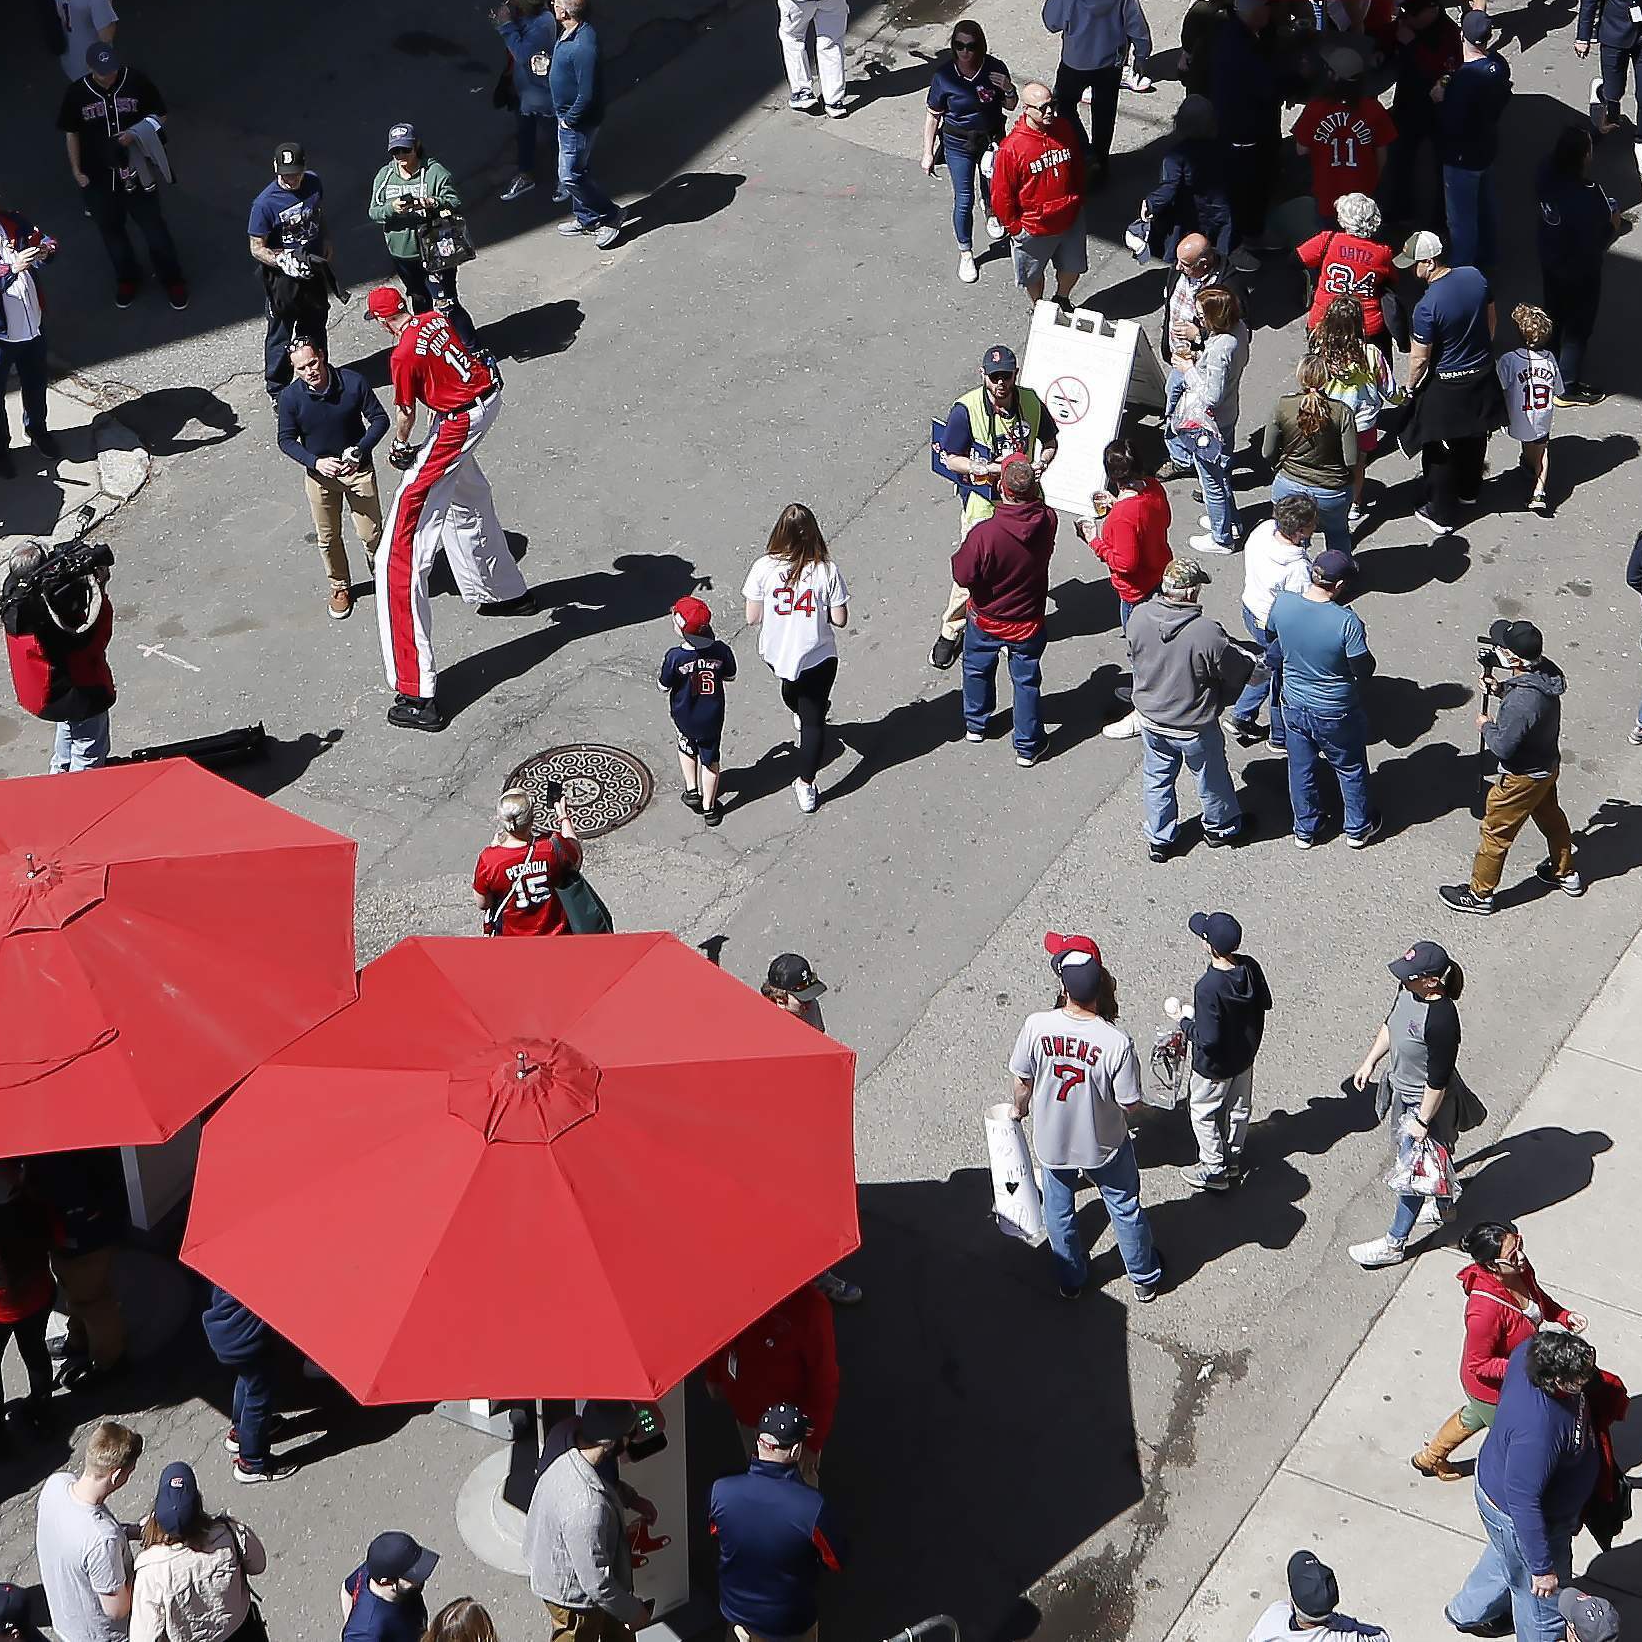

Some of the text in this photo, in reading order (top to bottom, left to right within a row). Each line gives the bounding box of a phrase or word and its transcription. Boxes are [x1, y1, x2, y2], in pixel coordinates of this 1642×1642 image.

[1313, 111, 1350, 144] SCOTTY
[282, 151, 294, 164] B
[1330, 137, 1357, 167] 11
[1325, 263, 1376, 297] 34
[773, 587, 815, 618] 34
[514, 872, 551, 908] 15
[1041, 1034, 1102, 1066] OWENS
[1053, 1064, 1086, 1102] 7
